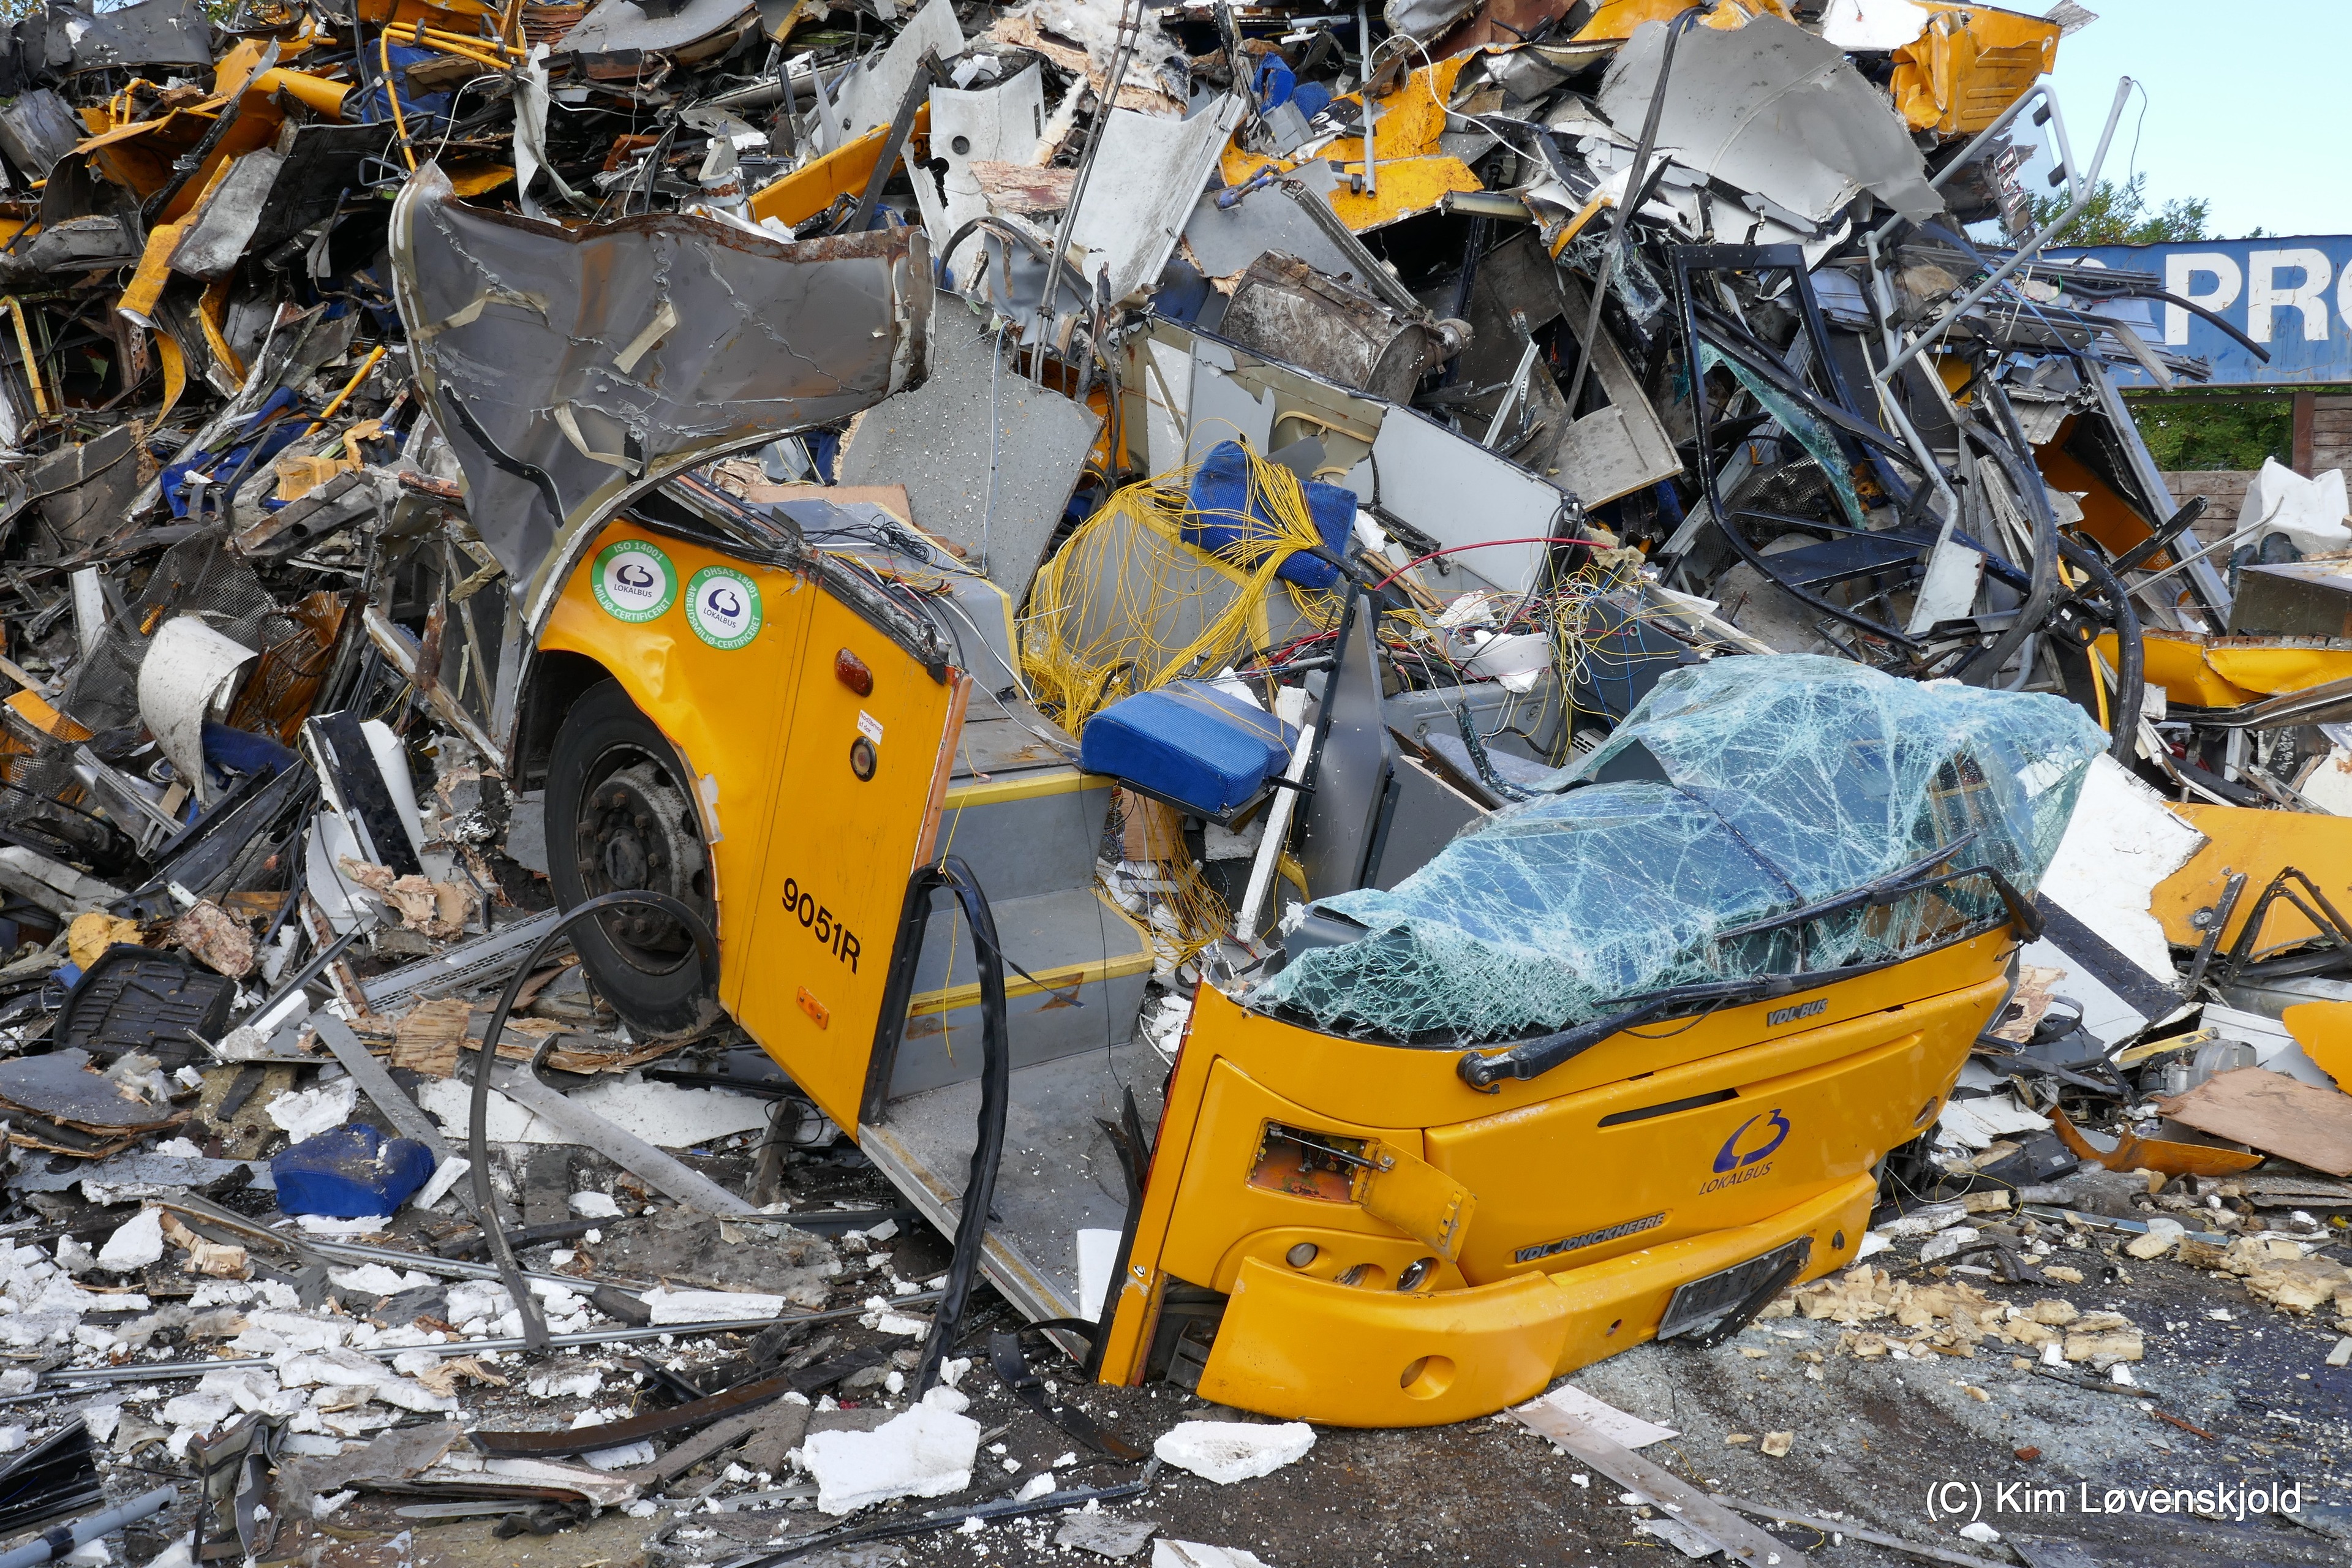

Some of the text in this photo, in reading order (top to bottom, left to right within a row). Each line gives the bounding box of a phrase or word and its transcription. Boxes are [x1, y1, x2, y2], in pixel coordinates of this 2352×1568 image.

[2165, 249, 2352, 345] PR
[614, 542, 663, 562] ISO 14001
[614, 584, 652, 598] LOKALBUS
[703, 567, 758, 599] OHSAS 18001
[594, 583, 670, 621] MILJØ-CERTIFICERET
[687, 584, 760, 648] ARBEJDSMILJØ-CERTIFICERET
[703, 607, 737, 628] LOKALBUS
[782, 877, 861, 975] 9051R
[1767, 998, 1829, 1027] VDL BUS
[1698, 1161, 1773, 1196] LOKALBUS
[1515, 1212, 1666, 1263] VDL JONCKHEERE
